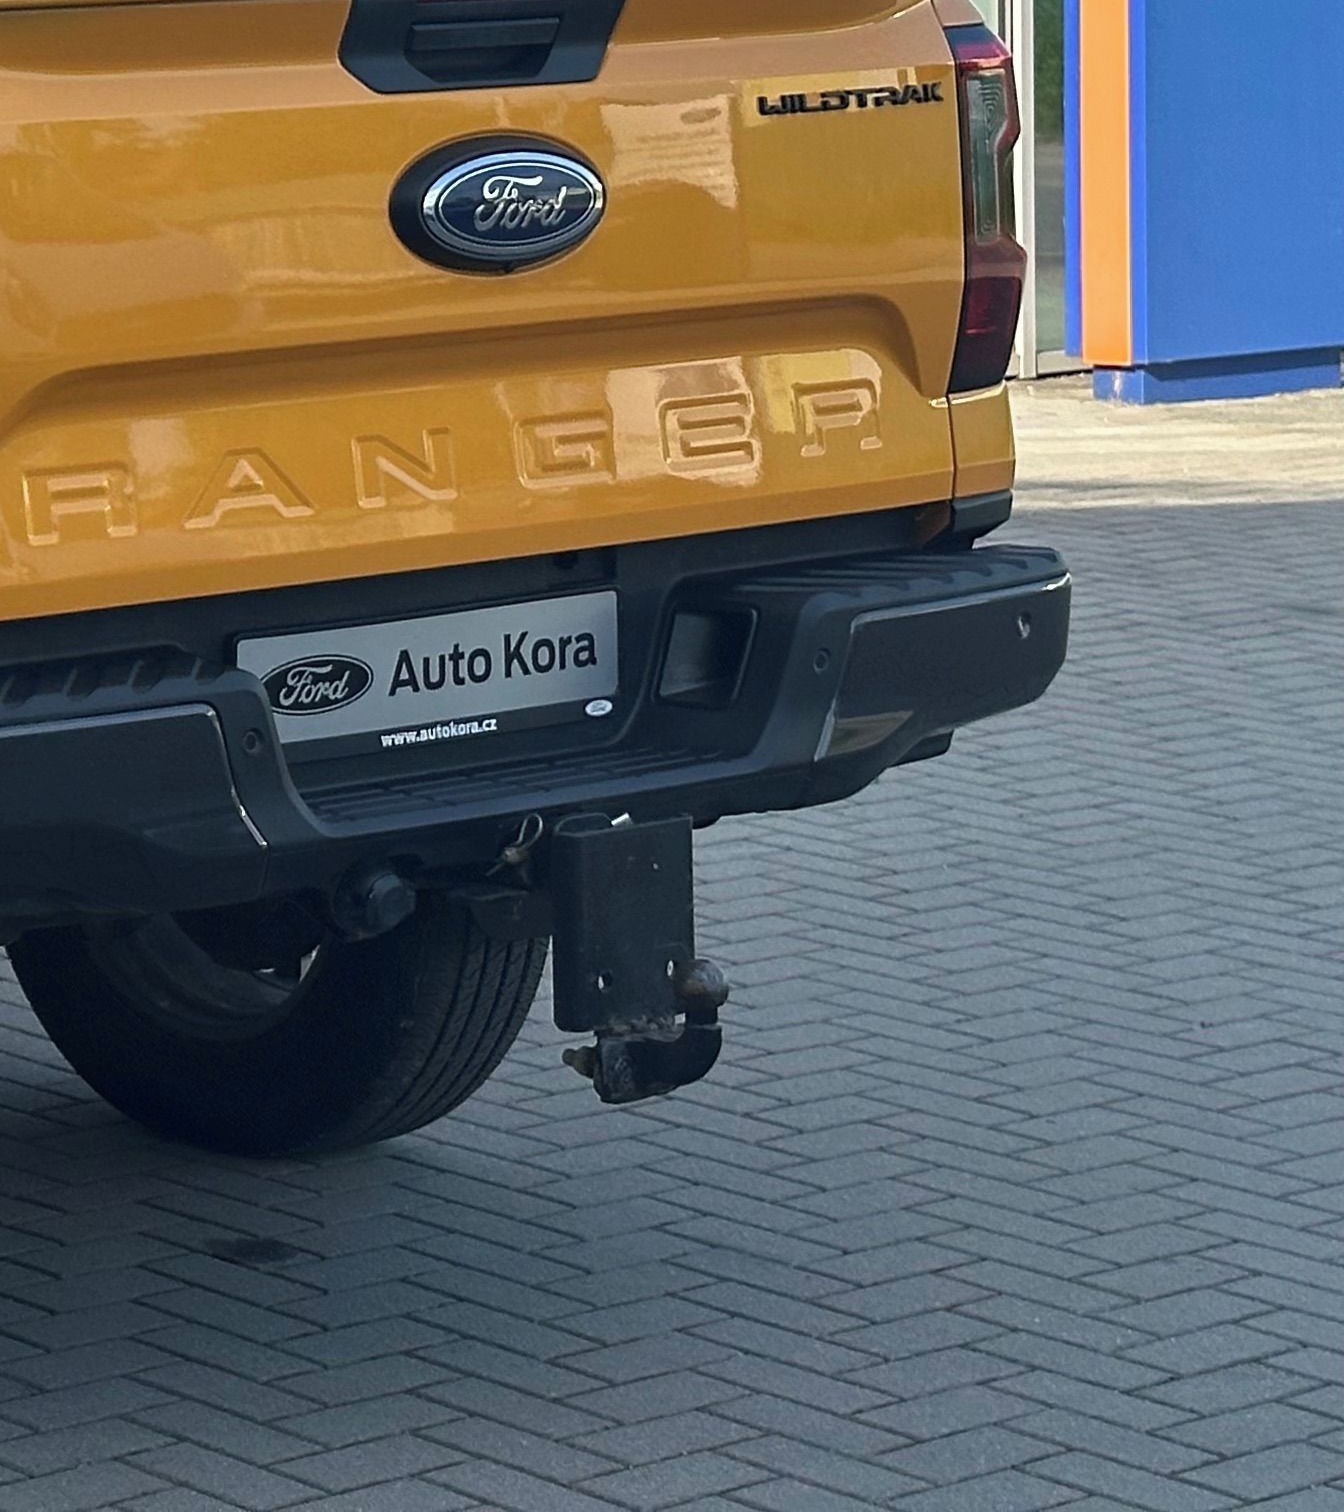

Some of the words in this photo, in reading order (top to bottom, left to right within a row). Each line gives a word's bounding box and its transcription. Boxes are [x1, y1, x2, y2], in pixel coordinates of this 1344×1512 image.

[756, 81, 945, 116] WILDTRAK
[472, 175, 567, 231] Ford
[21, 376, 883, 547] RANGER
[279, 664, 350, 706] Ford
[388, 643, 492, 697] Auto
[503, 631, 597, 678] Kora
[380, 719, 497, 747] www.autokora.cz
